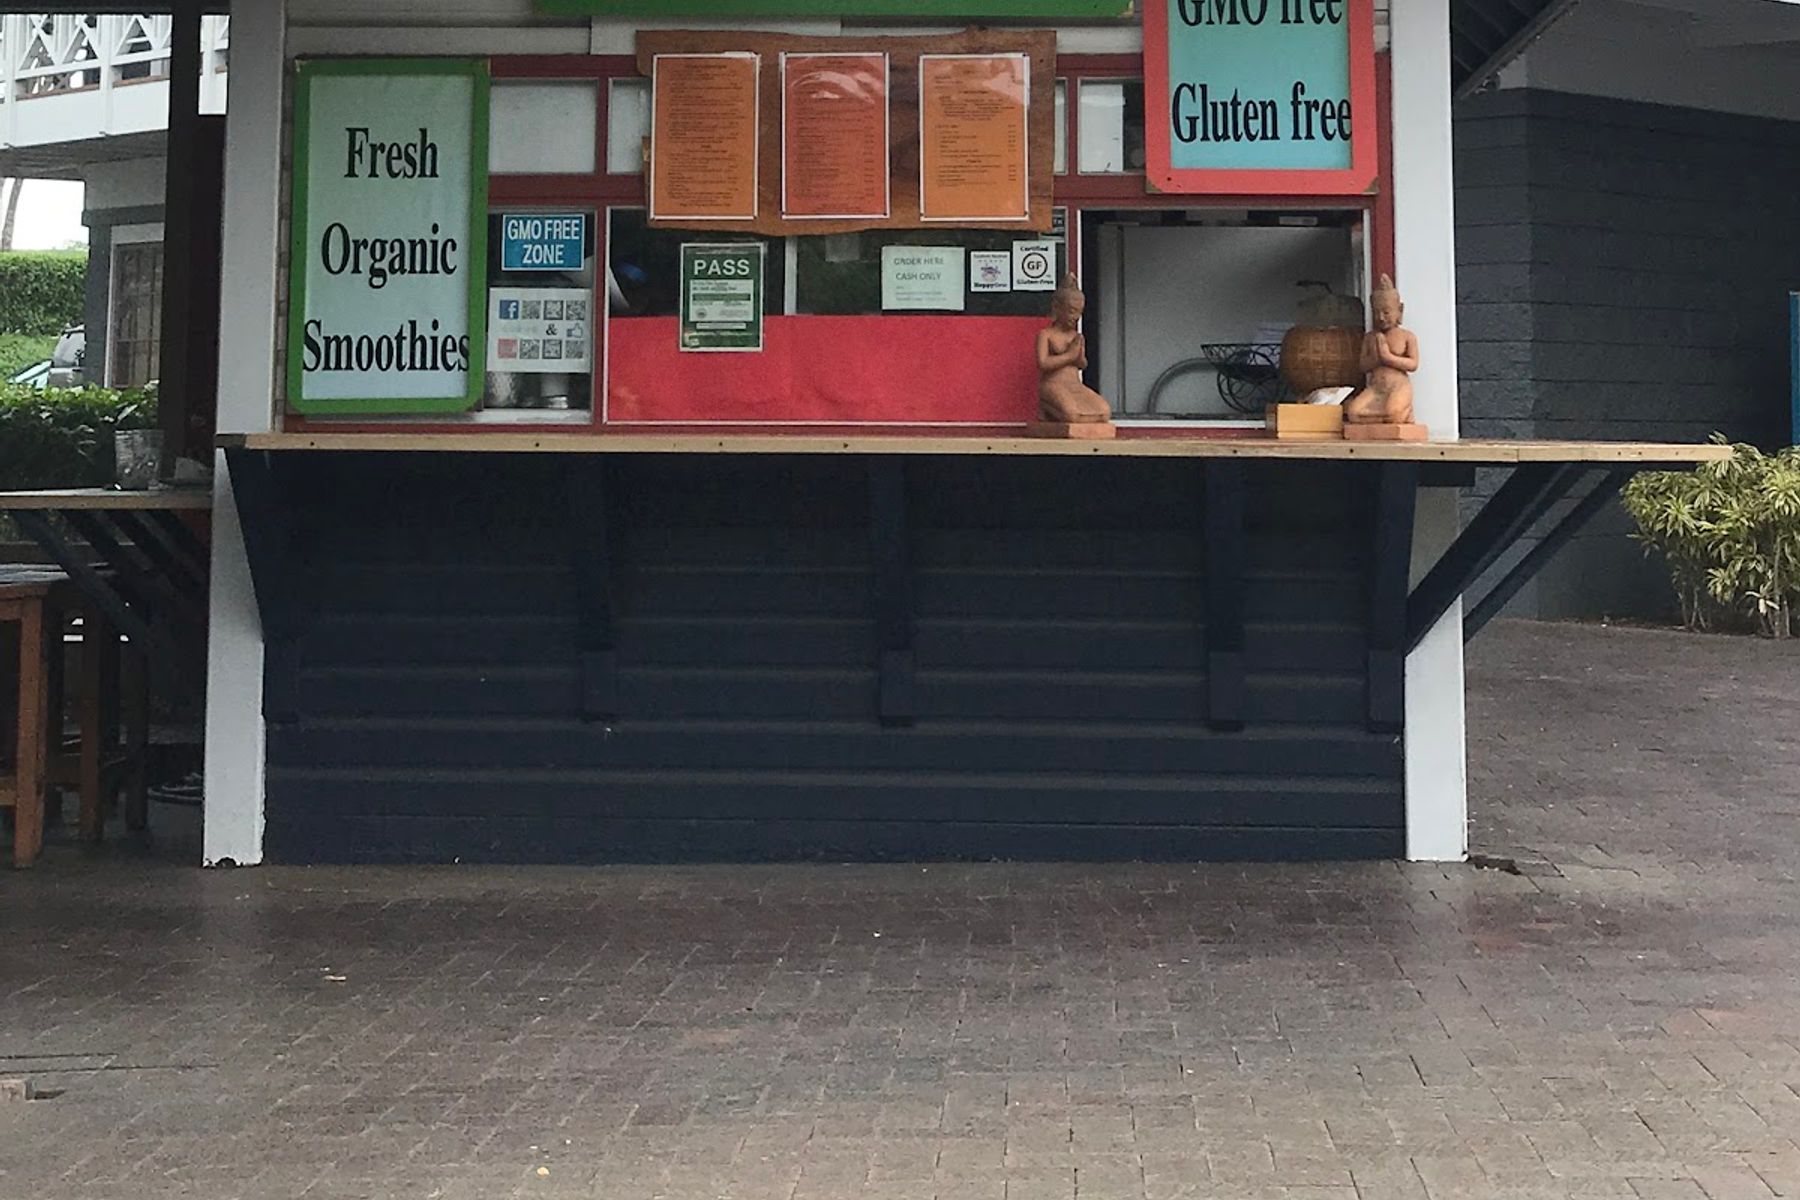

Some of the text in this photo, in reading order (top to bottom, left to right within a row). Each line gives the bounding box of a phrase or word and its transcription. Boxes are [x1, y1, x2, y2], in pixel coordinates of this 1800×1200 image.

[1172, 81, 1353, 143] Gluten free
[344, 127, 439, 179] Fresh
[507, 219, 581, 240] GMO FREE
[321, 222, 457, 289] Organic
[522, 244, 565, 265] ZONE
[894, 257, 944, 266] ORDER HERE
[693, 259, 750, 276] PASS
[1027, 261, 1042, 270] GF
[895, 272, 942, 281] CASH ONLY
[545, 323, 558, 336] &
[303, 319, 470, 373] Smoothies
